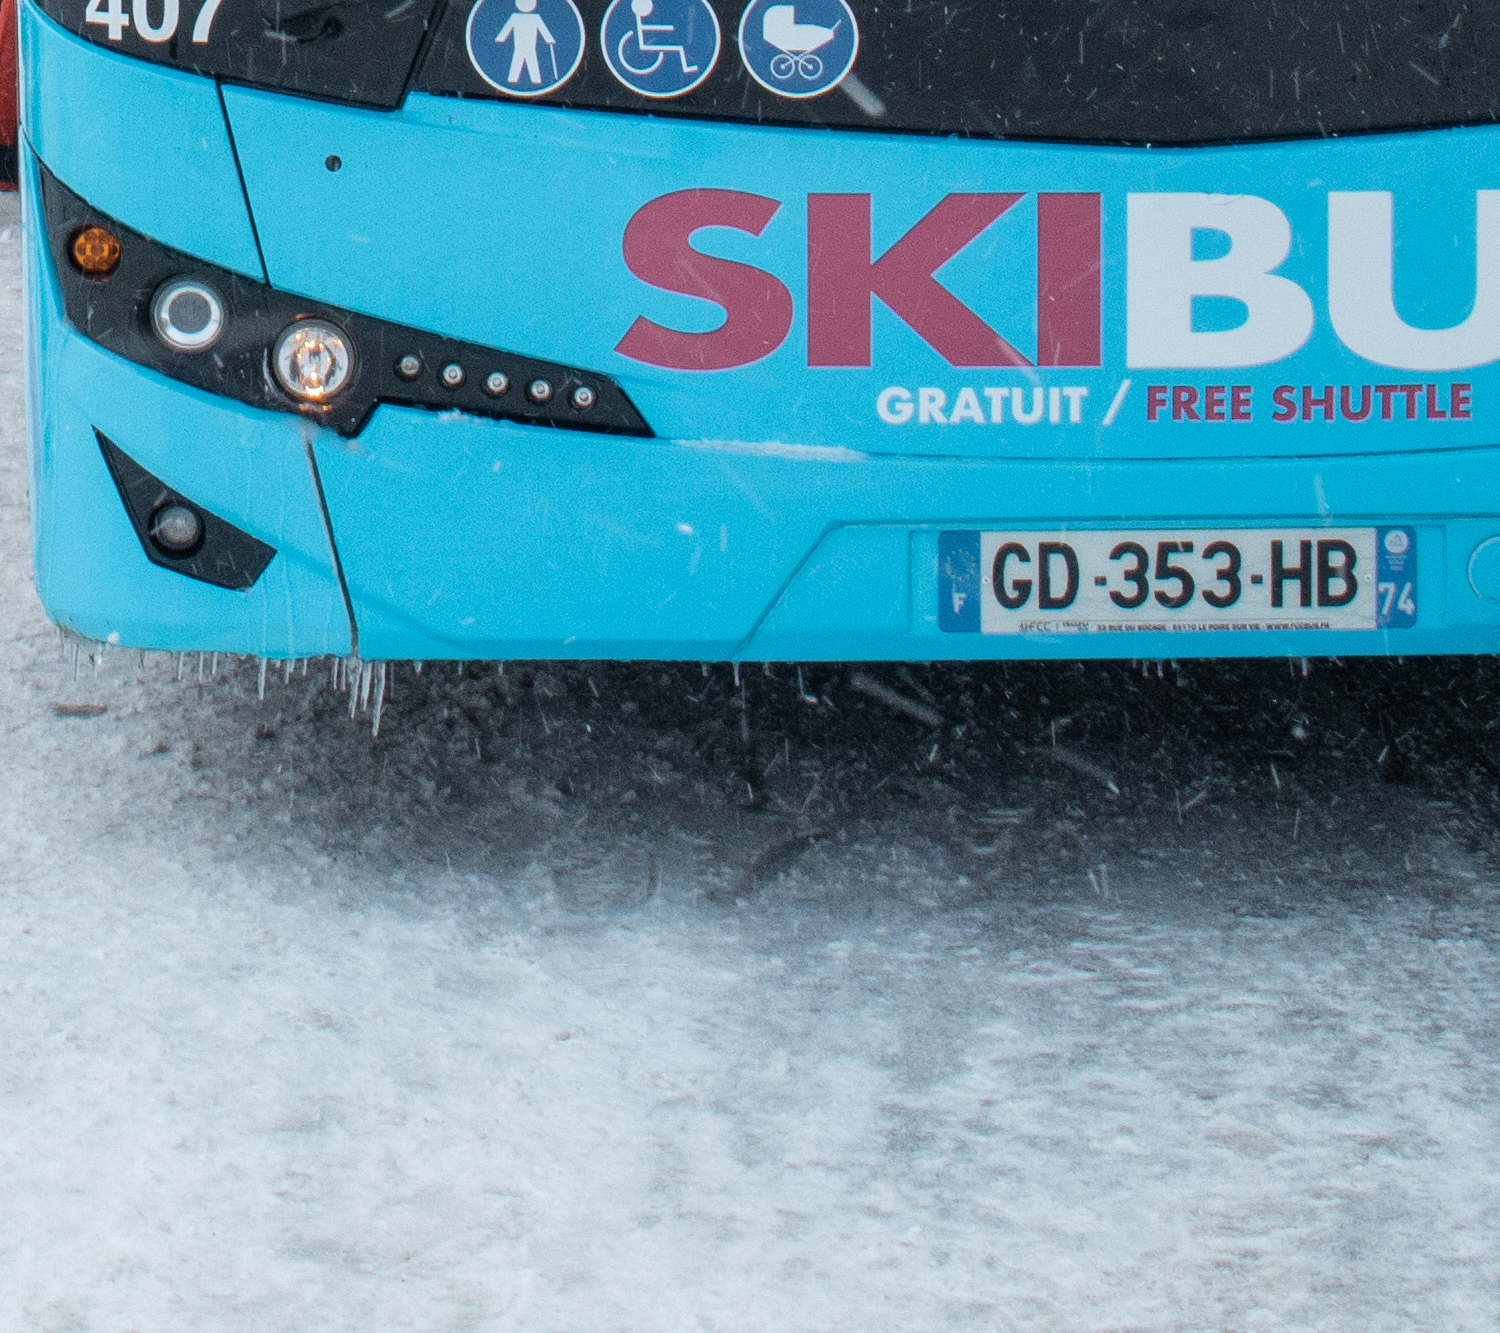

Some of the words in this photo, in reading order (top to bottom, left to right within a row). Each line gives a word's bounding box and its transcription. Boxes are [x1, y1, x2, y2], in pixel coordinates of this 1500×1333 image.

[876, 385, 1089, 425] GRATUIT
[1146, 384, 1253, 422] FREE
[1271, 383, 1472, 422] SHUTTLE
[991, 538, 1359, 610] GD-353-HB
[1377, 581, 1416, 616] 74
